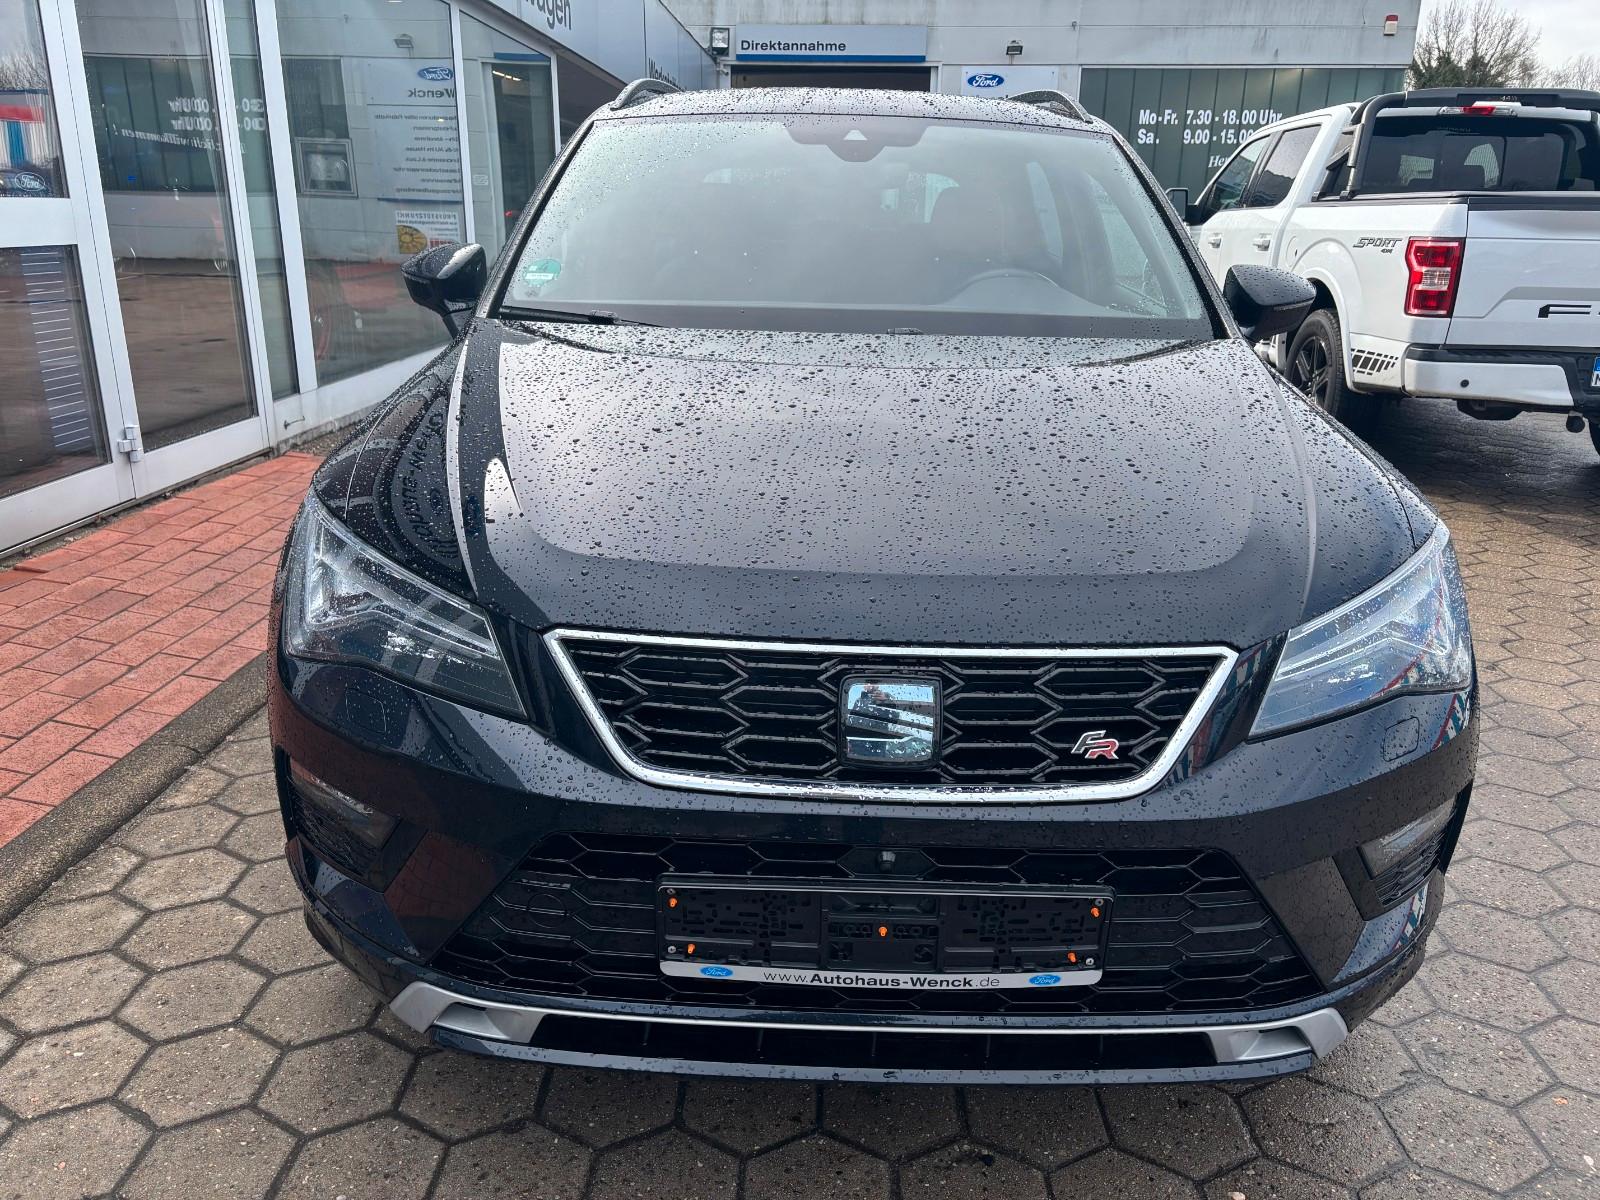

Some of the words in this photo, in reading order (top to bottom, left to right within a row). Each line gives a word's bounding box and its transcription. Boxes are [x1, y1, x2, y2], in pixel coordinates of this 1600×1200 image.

[526, 0, 572, 30] agen
[741, 40, 847, 52] Direktannahme
[971, 74, 1001, 88] Ford
[1186, 110, 1212, 125] 7.30
[1222, 110, 1257, 125] 18.00
[1259, 110, 1283, 125] Uhr
[1137, 129, 1160, 144] Sa.
[1183, 129, 1210, 144] 9.00
[1352, 236, 1403, 248] SPORT
[1071, 730, 1119, 760] FR
[763, 971, 1000, 988] www.Autohaus-Wenck.de
